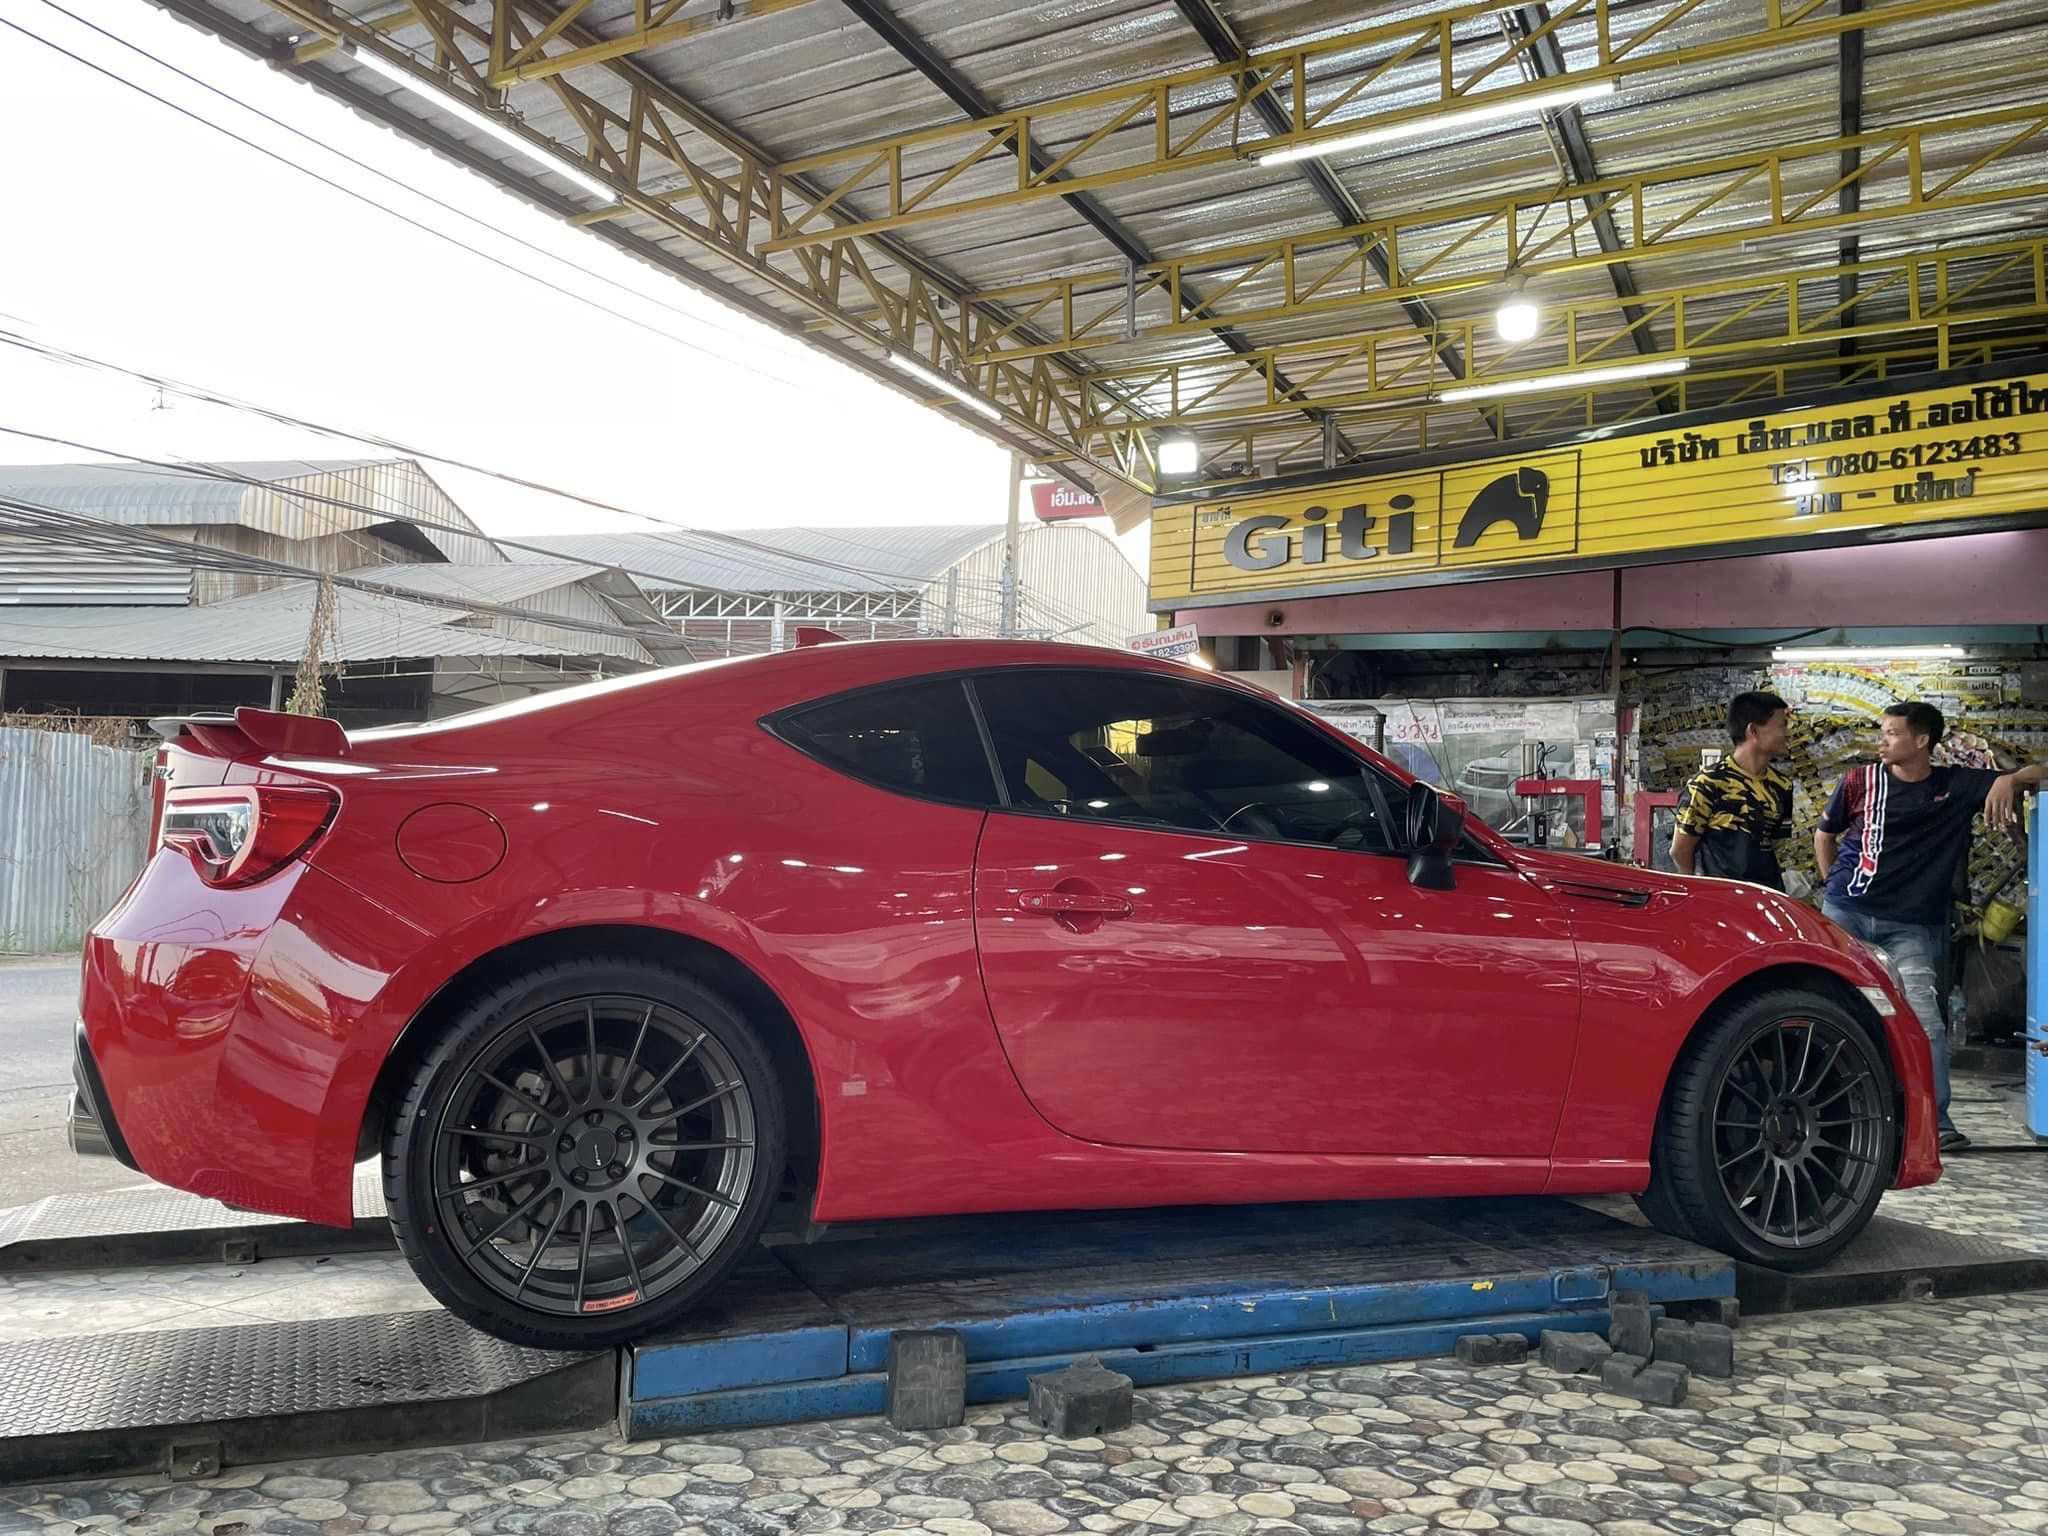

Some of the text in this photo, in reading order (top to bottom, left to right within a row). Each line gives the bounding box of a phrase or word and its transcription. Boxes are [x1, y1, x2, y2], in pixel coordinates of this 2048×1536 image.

[1640, 432, 1719, 467] บริษัท
[1768, 432, 2021, 485] Tel. 080-6123483
[1893, 466, 1981, 503] แม็กซ์
[1224, 494, 1415, 571] Giti
